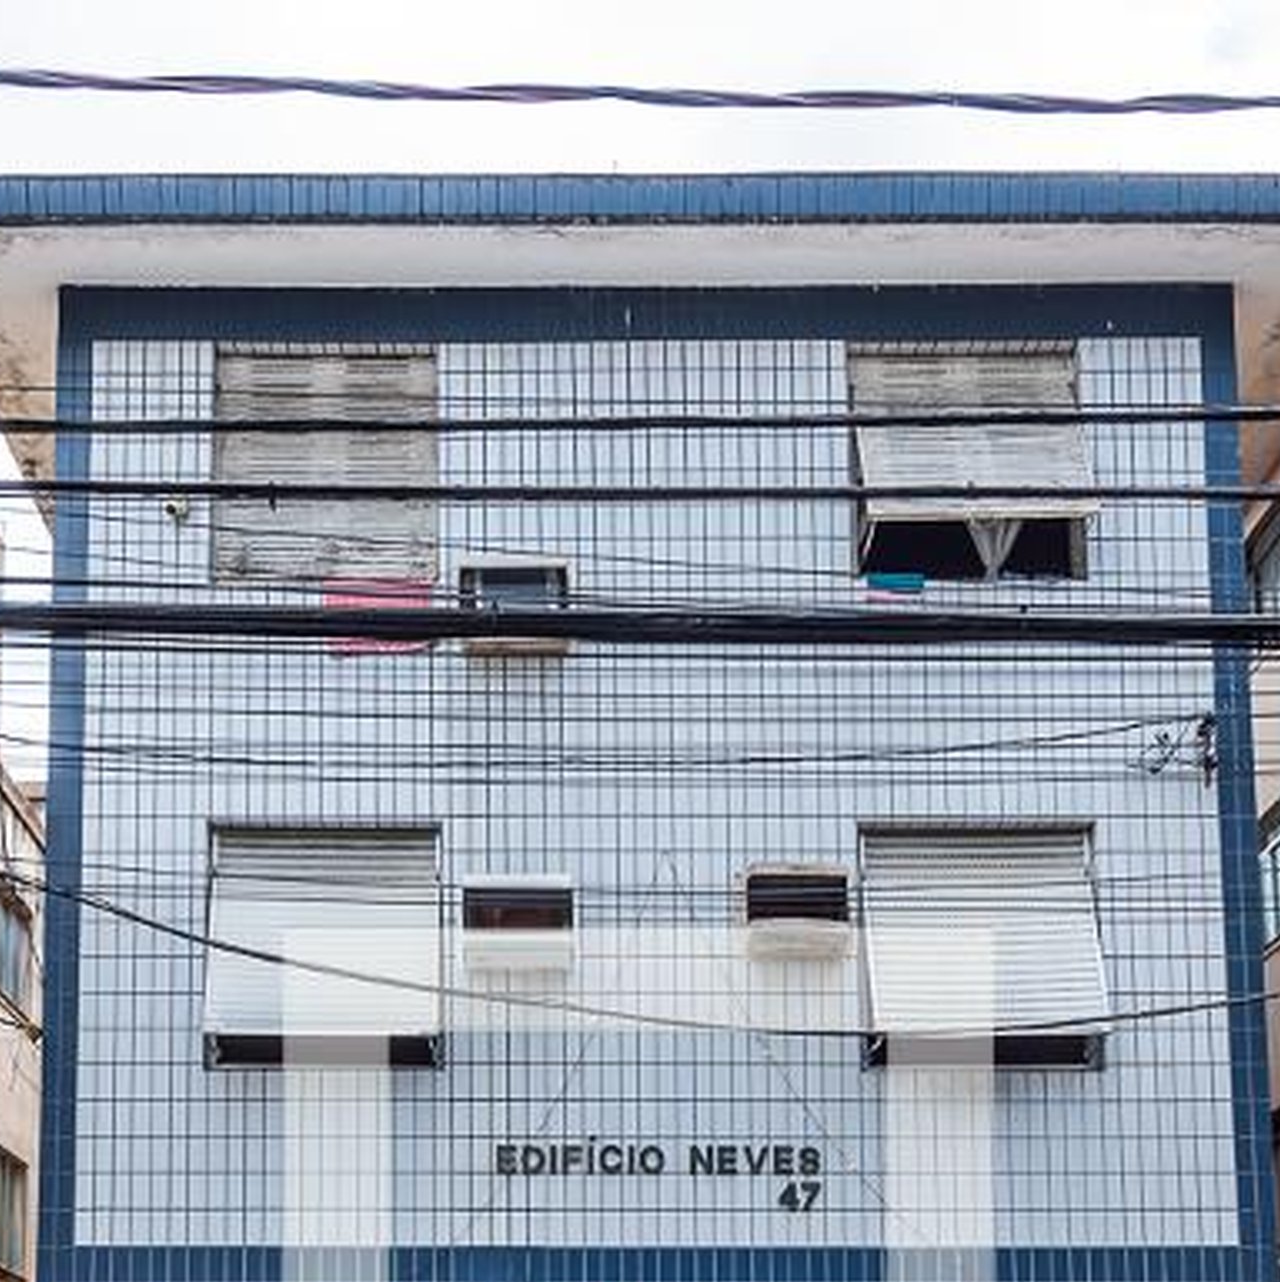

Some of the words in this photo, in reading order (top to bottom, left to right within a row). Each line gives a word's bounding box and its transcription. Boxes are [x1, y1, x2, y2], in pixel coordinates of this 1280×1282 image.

[495, 1136, 665, 1175] EDIFÍCIO
[689, 1145, 821, 1175] NEVES
[778, 1182, 821, 1211] 47
